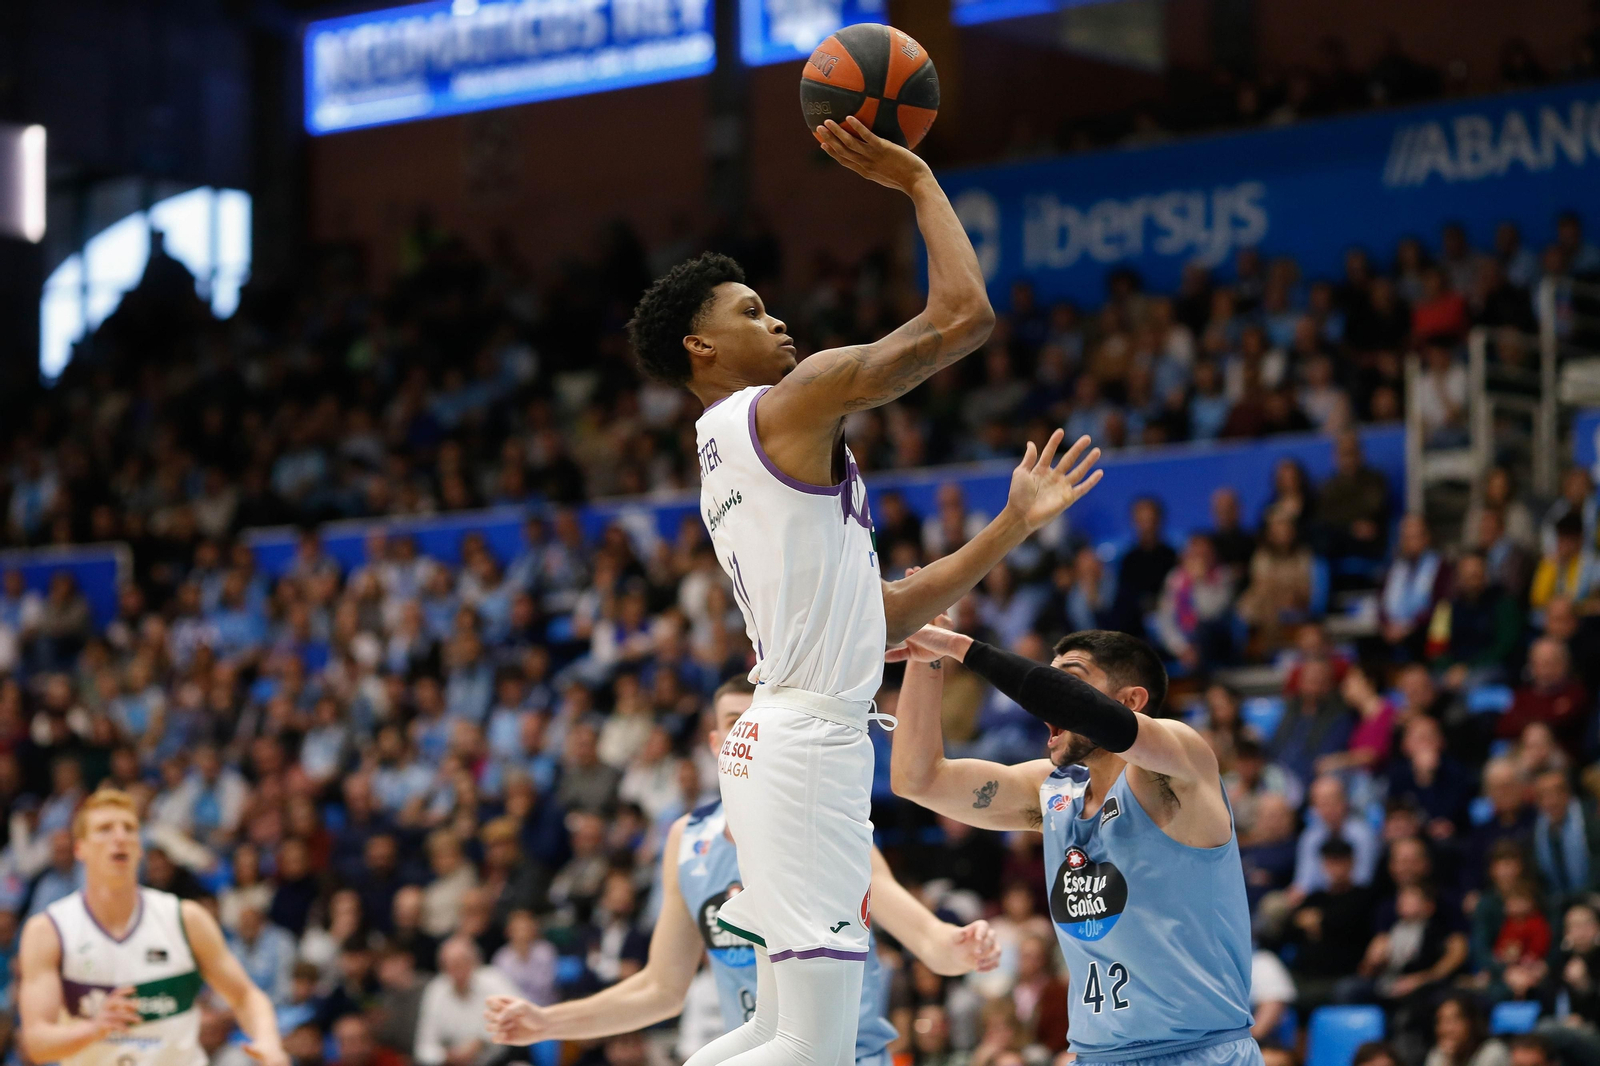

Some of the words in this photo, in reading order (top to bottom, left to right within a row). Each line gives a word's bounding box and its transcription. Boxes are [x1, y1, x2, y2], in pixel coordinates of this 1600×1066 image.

[1383, 101, 1600, 186] ABAN
[731, 742, 753, 761] SOL
[1082, 961, 1129, 1014] 42
